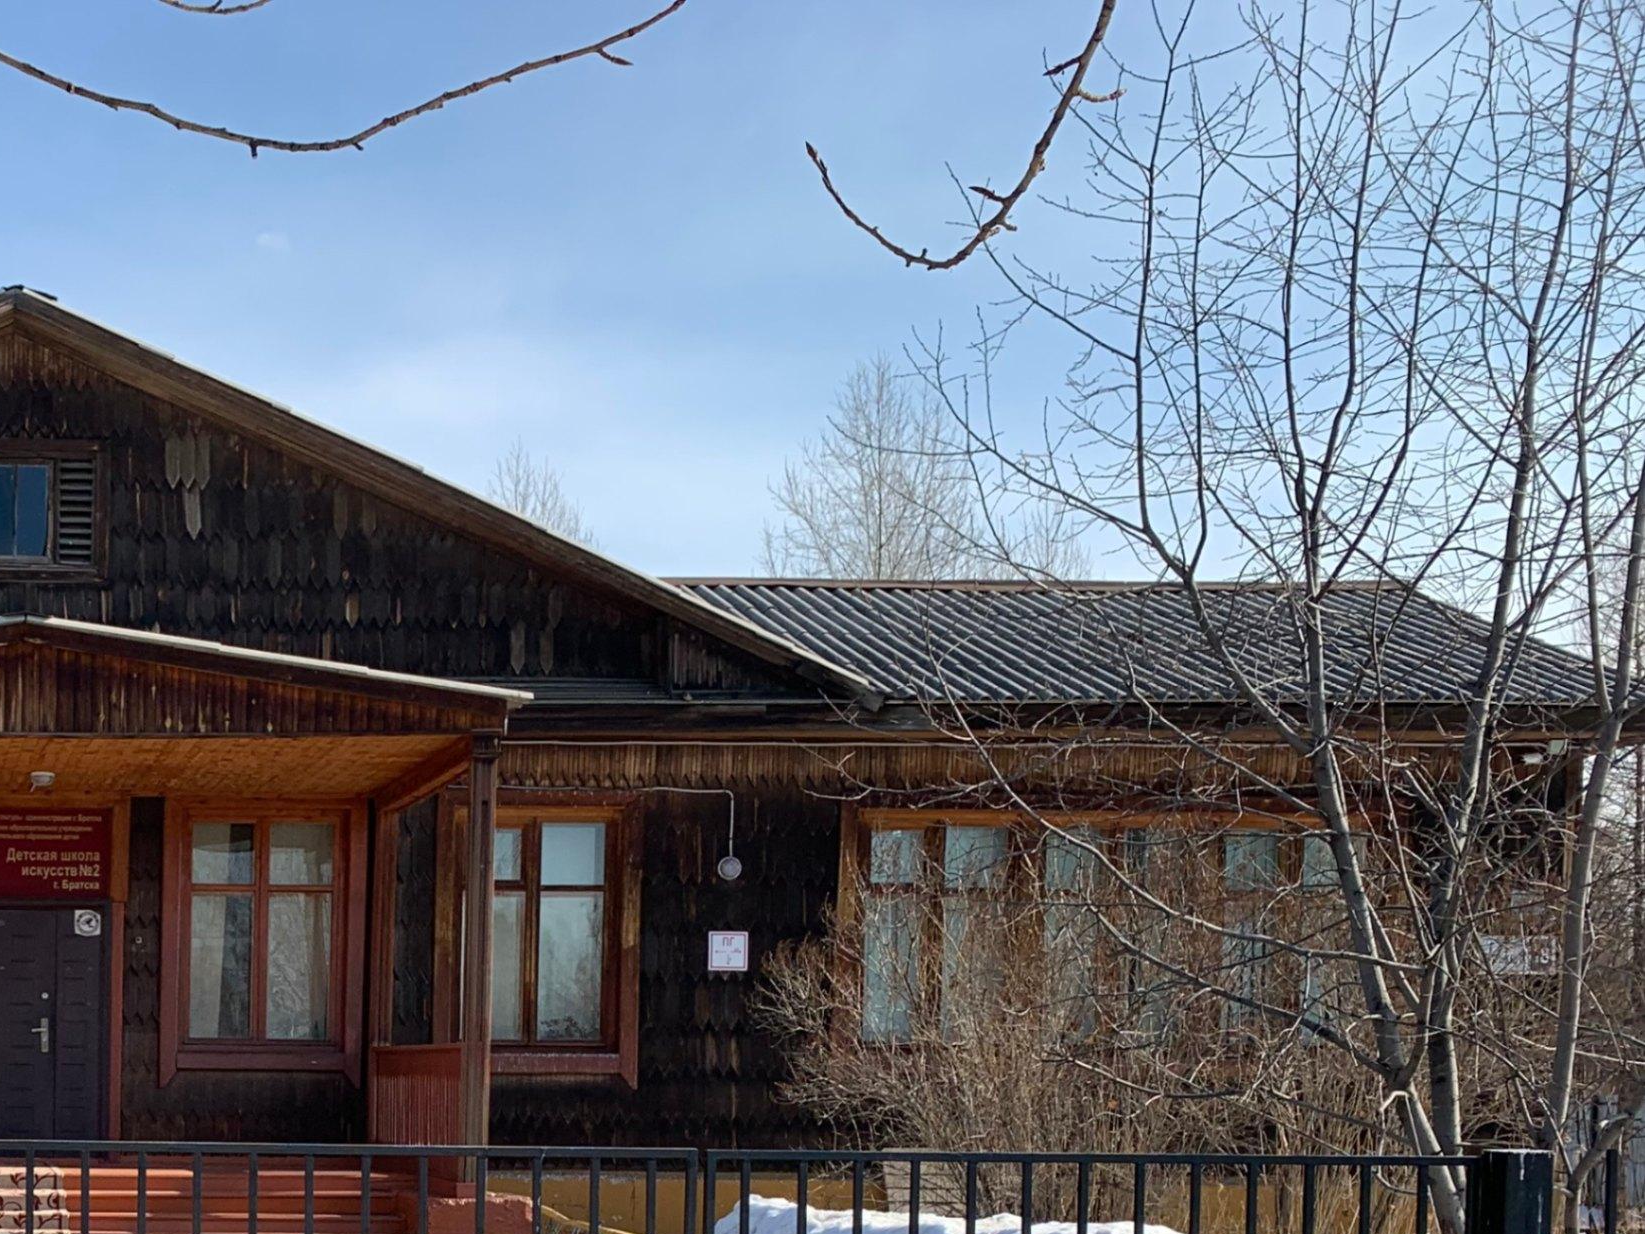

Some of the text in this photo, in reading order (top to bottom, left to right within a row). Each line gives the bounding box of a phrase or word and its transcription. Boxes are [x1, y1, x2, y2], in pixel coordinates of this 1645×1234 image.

[6, 848, 100, 863] Детская школа
[21, 864, 100, 880] искусств №2
[62, 879, 100, 891] Братска
